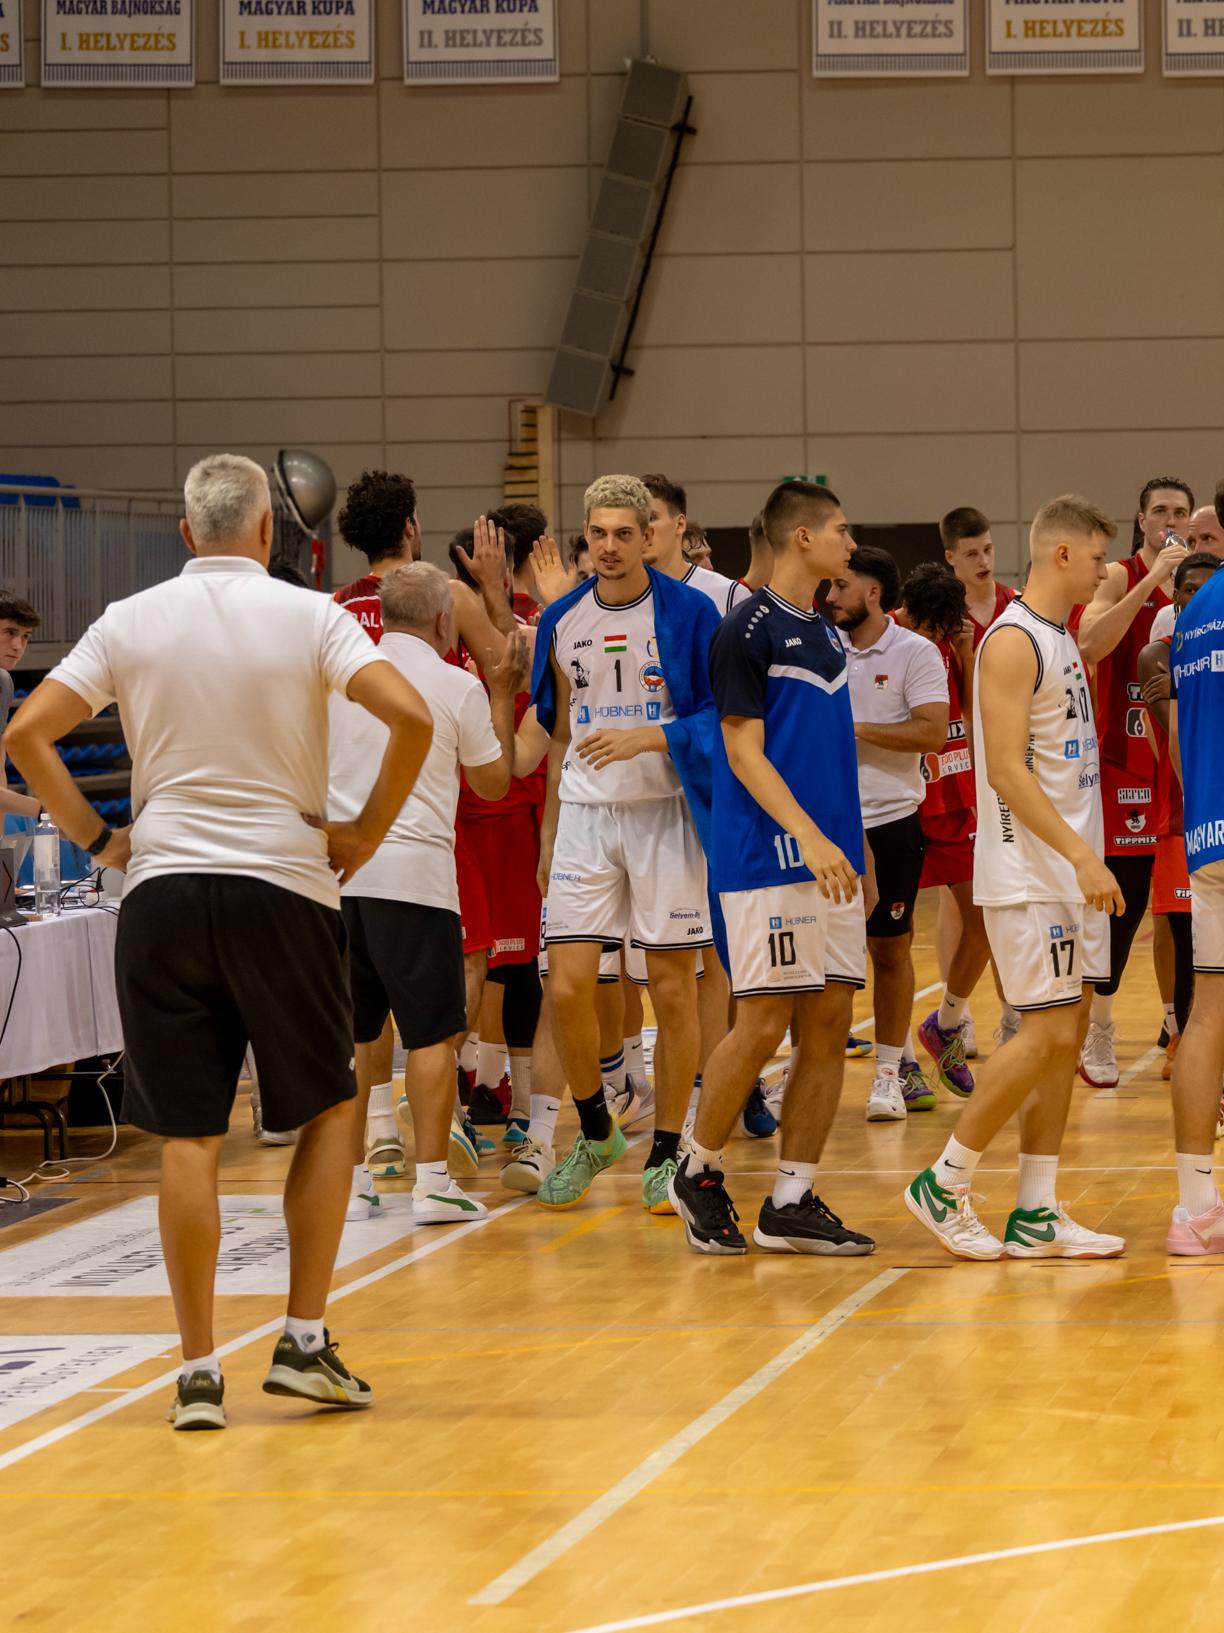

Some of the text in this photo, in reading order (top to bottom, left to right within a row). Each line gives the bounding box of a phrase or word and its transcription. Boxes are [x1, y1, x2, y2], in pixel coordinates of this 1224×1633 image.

[312, 0, 355, 15] KUPA
[238, 23, 355, 49] I. HELYEZÉS
[418, 22, 544, 48] II. HELYEZÉS
[828, 13, 954, 39] II. HELYEZÉS
[1005, 11, 1125, 39] I. HELYEZÉS
[1177, 18, 1198, 38] II.
[60, 25, 177, 52] I. HELYEZÉS
[574, 639, 592, 650] JAKO
[784, 637, 802, 648] JAKO
[614, 659, 622, 692] 1
[774, 833, 804, 870] 10
[768, 931, 797, 967] 10
[1050, 938, 1075, 978] 17
